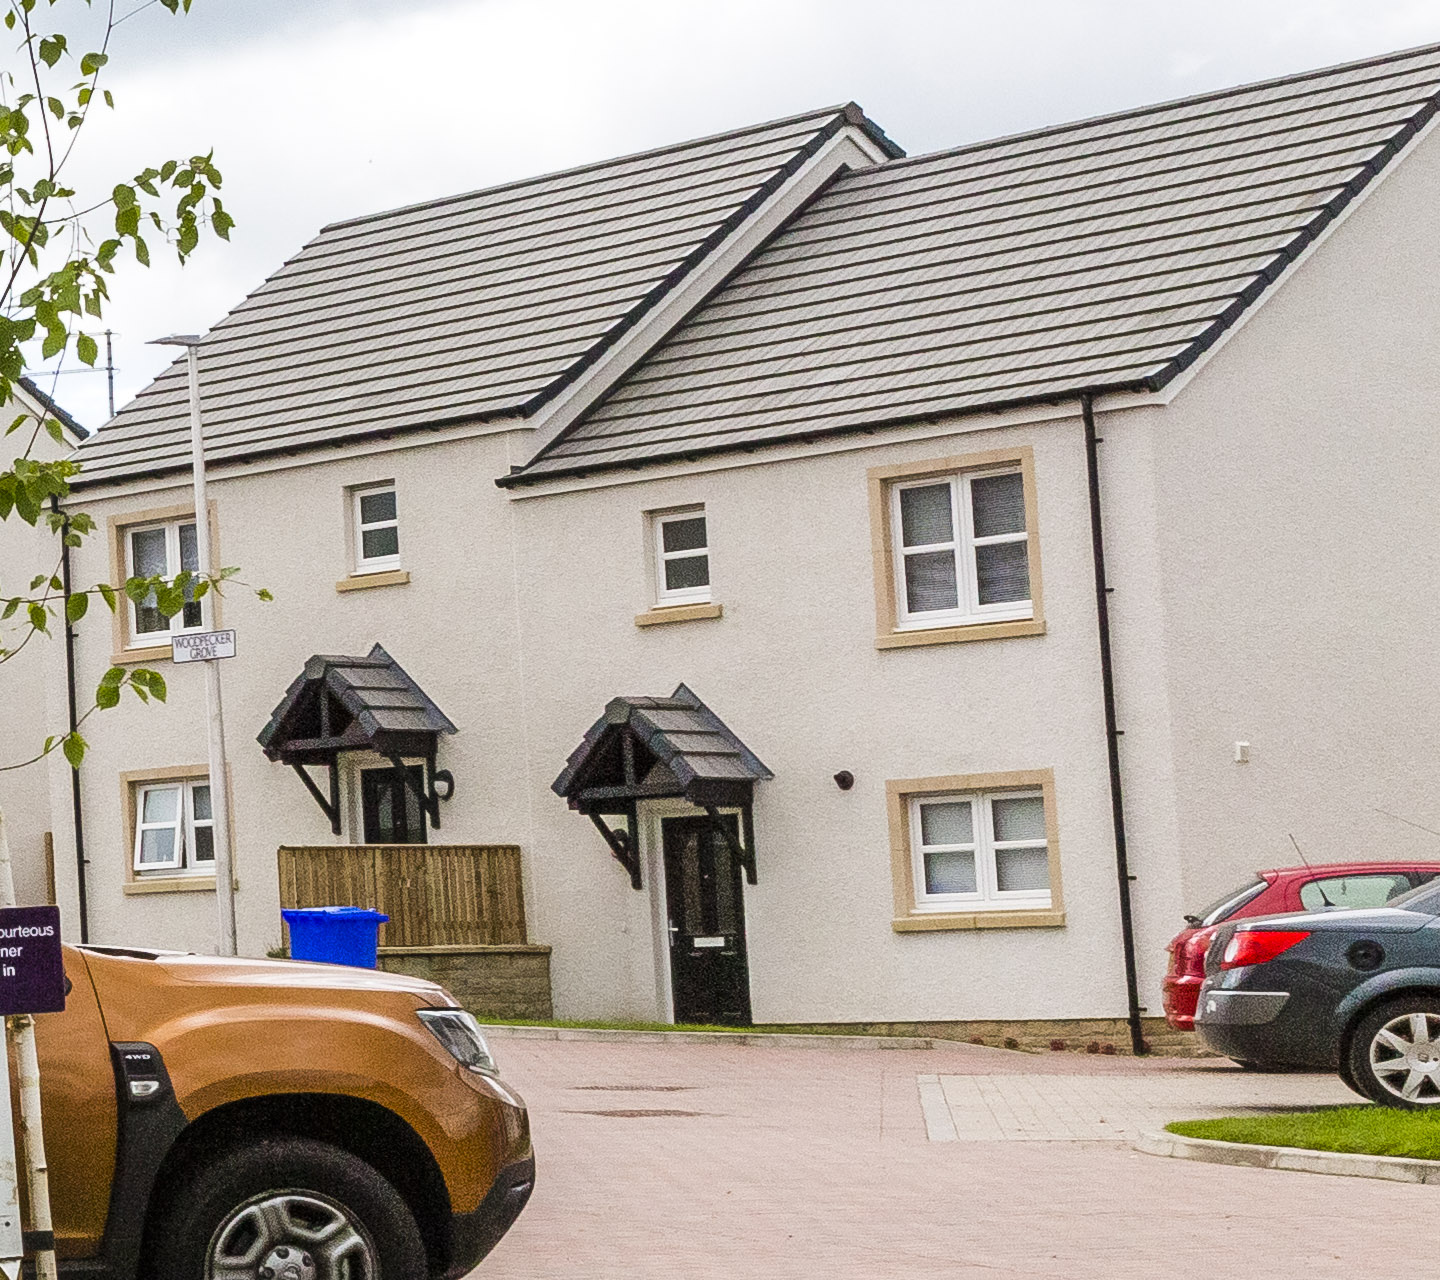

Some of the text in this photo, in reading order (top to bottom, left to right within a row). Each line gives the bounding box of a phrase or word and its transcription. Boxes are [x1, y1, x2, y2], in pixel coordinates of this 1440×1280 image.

[174, 633, 232, 648] WOODPECKER
[190, 646, 218, 660] GROVE
[2, 963, 16, 977] in
